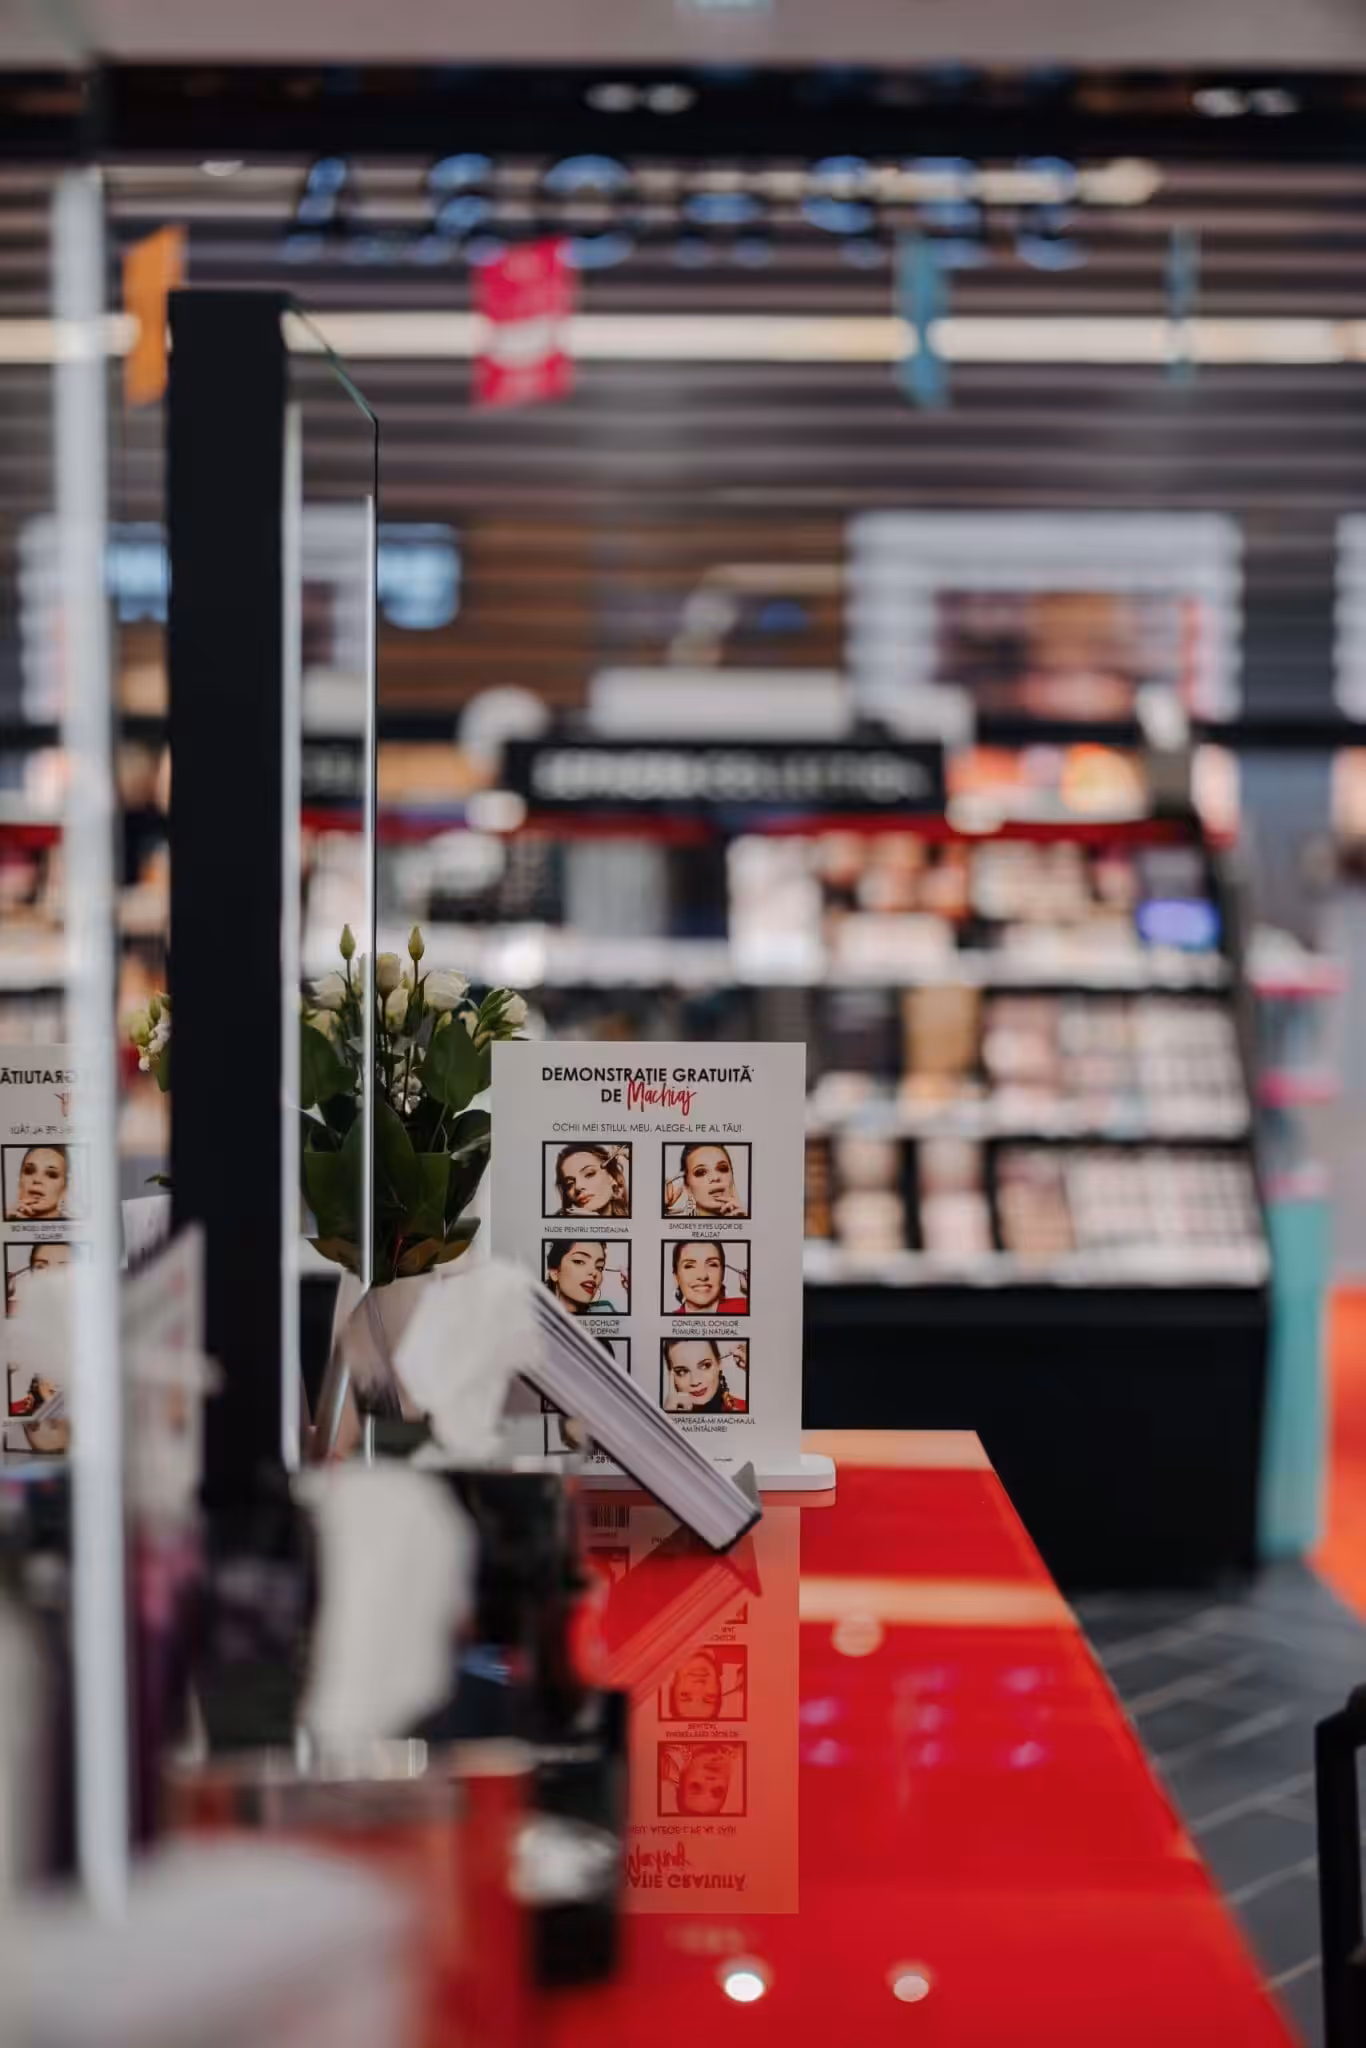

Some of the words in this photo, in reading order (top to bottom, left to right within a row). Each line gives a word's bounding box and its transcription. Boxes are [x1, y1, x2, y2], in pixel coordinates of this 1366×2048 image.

[541, 1067, 667, 1085] DEMONSTRAȚIE
[601, 1088, 622, 1103] DE
[627, 1077, 697, 1116] Machiaj
[582, 1123, 599, 1133] MEI
[601, 1123, 628, 1133] STILUL
[654, 1123, 694, 1133] ALEGE-L
[695, 1123, 706, 1133] PE
[709, 1123, 721, 1133] AL
